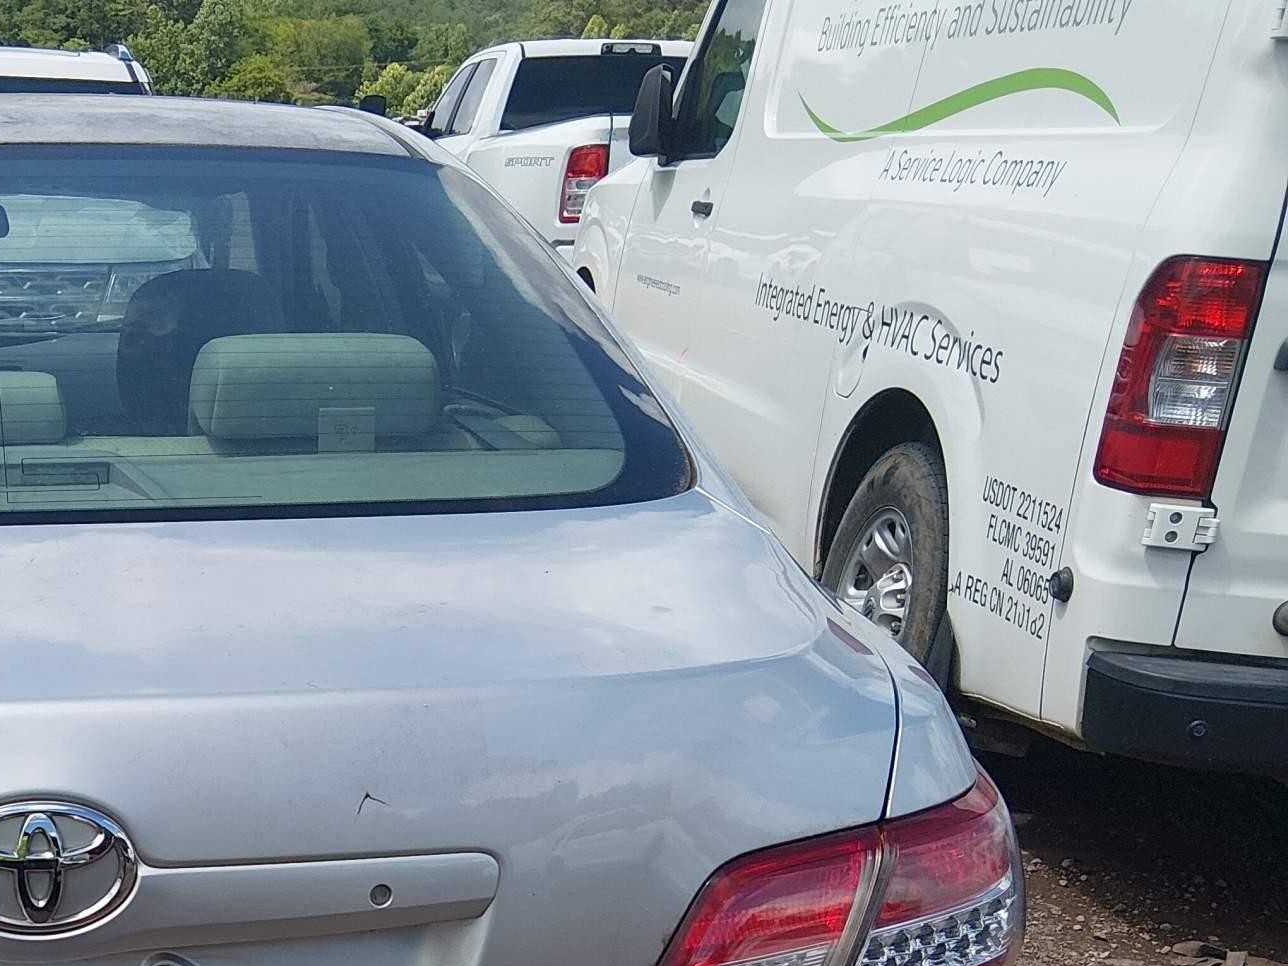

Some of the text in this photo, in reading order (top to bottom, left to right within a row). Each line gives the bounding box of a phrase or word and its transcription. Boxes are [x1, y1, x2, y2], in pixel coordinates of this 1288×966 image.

[817, 11, 871, 57] Building
[870, 0, 948, 51] Efficiency
[947, 0, 985, 39] and
[504, 156, 555, 167] SPORT
[878, 149, 1068, 198] A Service Logic Company
[754, 271, 1004, 384] Integrated Energy & HVAC Services
[982, 475, 1064, 535] USDOT 2211524
[986, 514, 1056, 570] FLCMC 39591
[948, 570, 963, 597] A
[964, 574, 989, 607] REG
[989, 587, 1005, 618] CN
[1000, 557, 1051, 605] AL 06065
